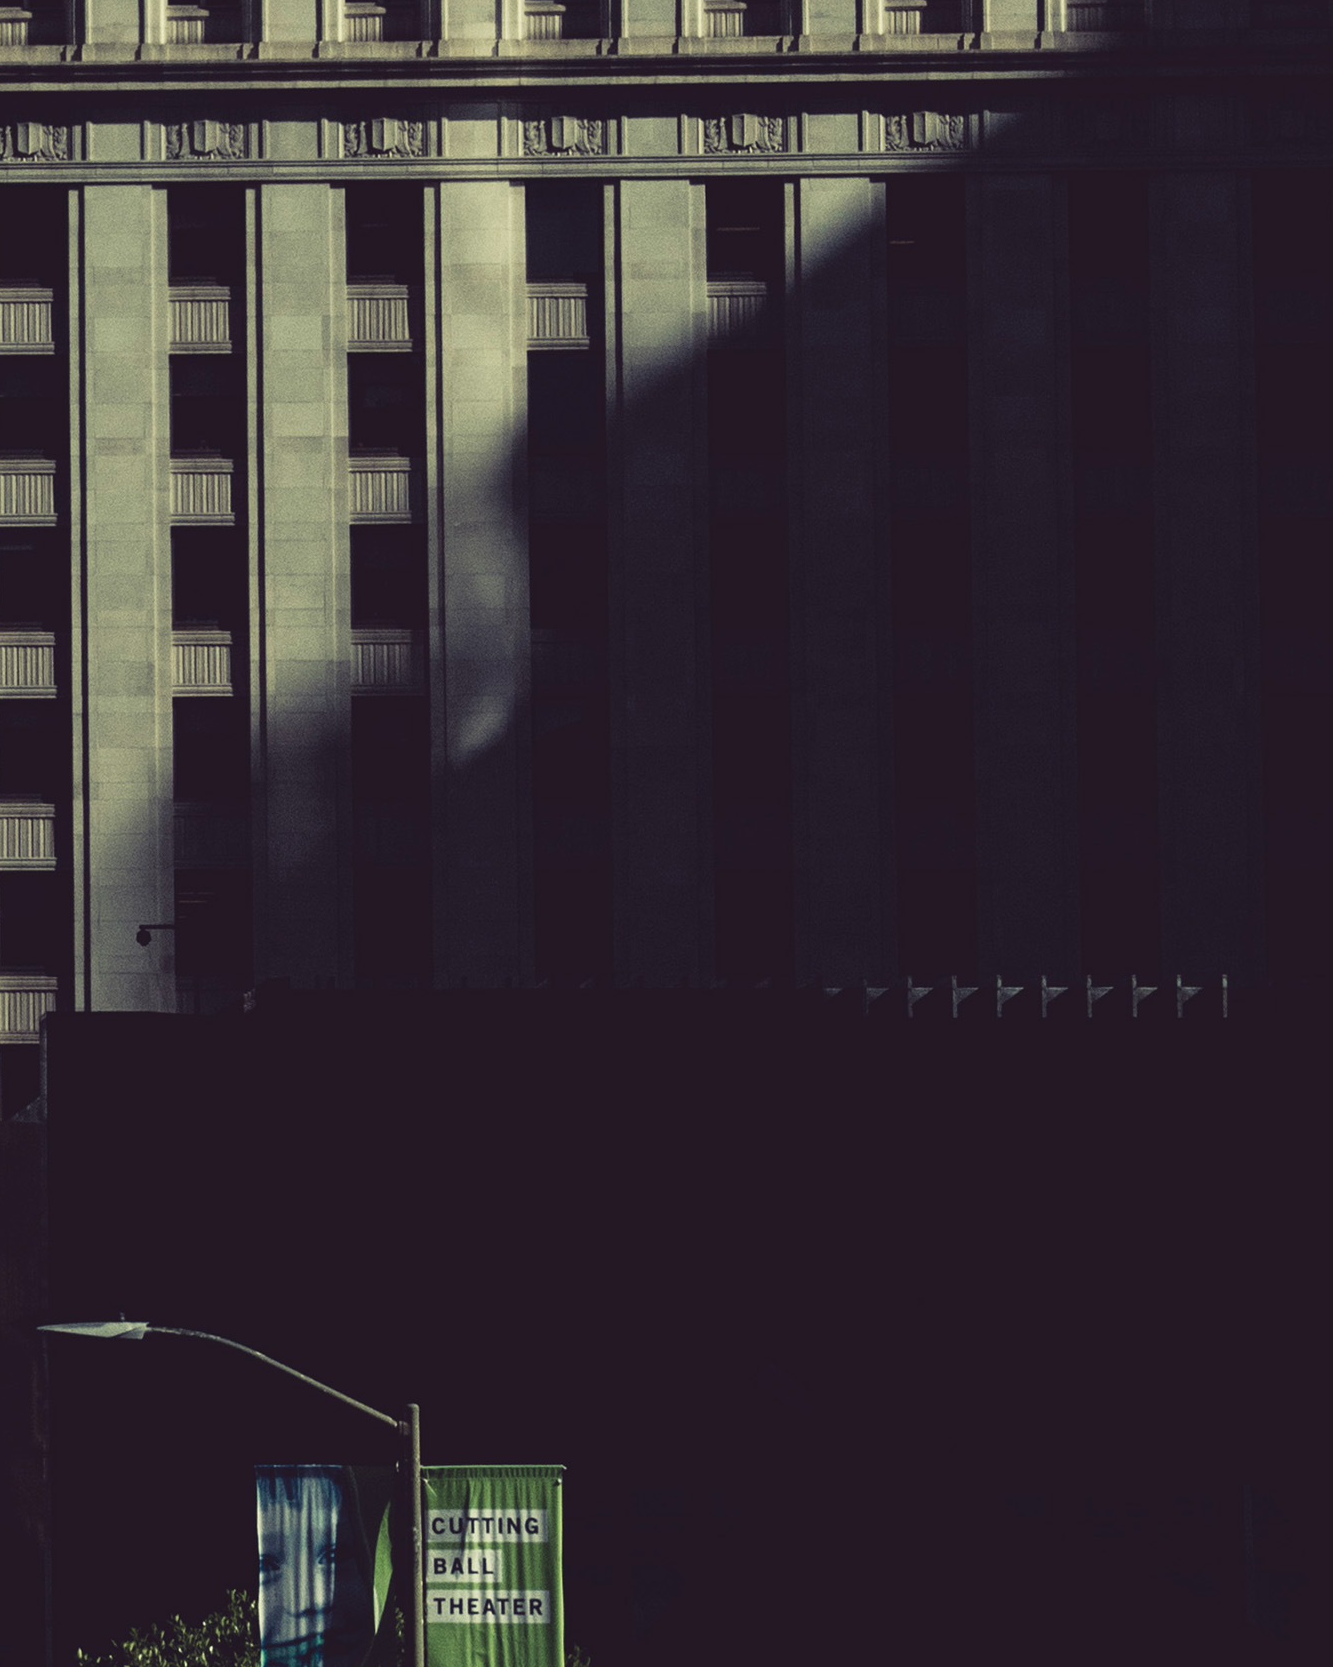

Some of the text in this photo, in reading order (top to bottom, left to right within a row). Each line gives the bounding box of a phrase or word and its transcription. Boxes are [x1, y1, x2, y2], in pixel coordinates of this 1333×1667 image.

[431, 1517, 540, 1536] CUTTING
[433, 1557, 494, 1576] BALL
[433, 1597, 543, 1617] THEATER
